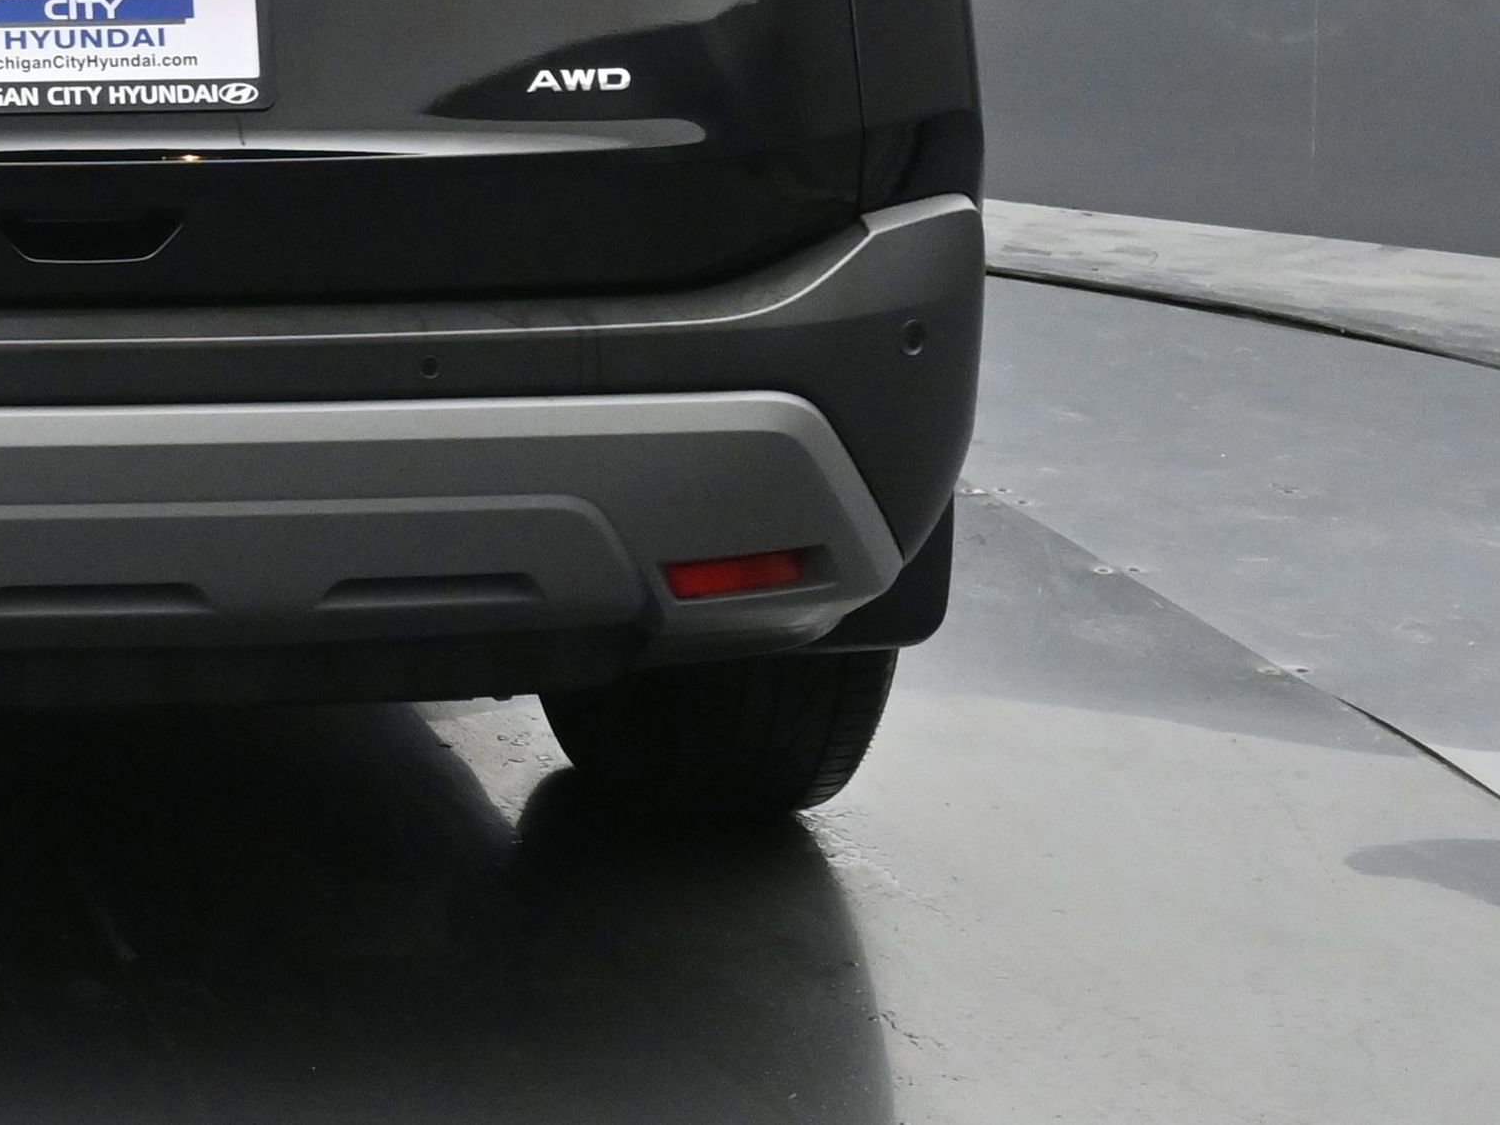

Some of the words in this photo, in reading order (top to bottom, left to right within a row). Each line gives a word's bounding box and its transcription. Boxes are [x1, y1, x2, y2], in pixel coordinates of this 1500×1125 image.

[4, 27, 166, 50] HYUNDAI
[526, 67, 632, 93] AWD
[47, 85, 102, 106] CITY
[108, 84, 218, 105] HYUNDAI
